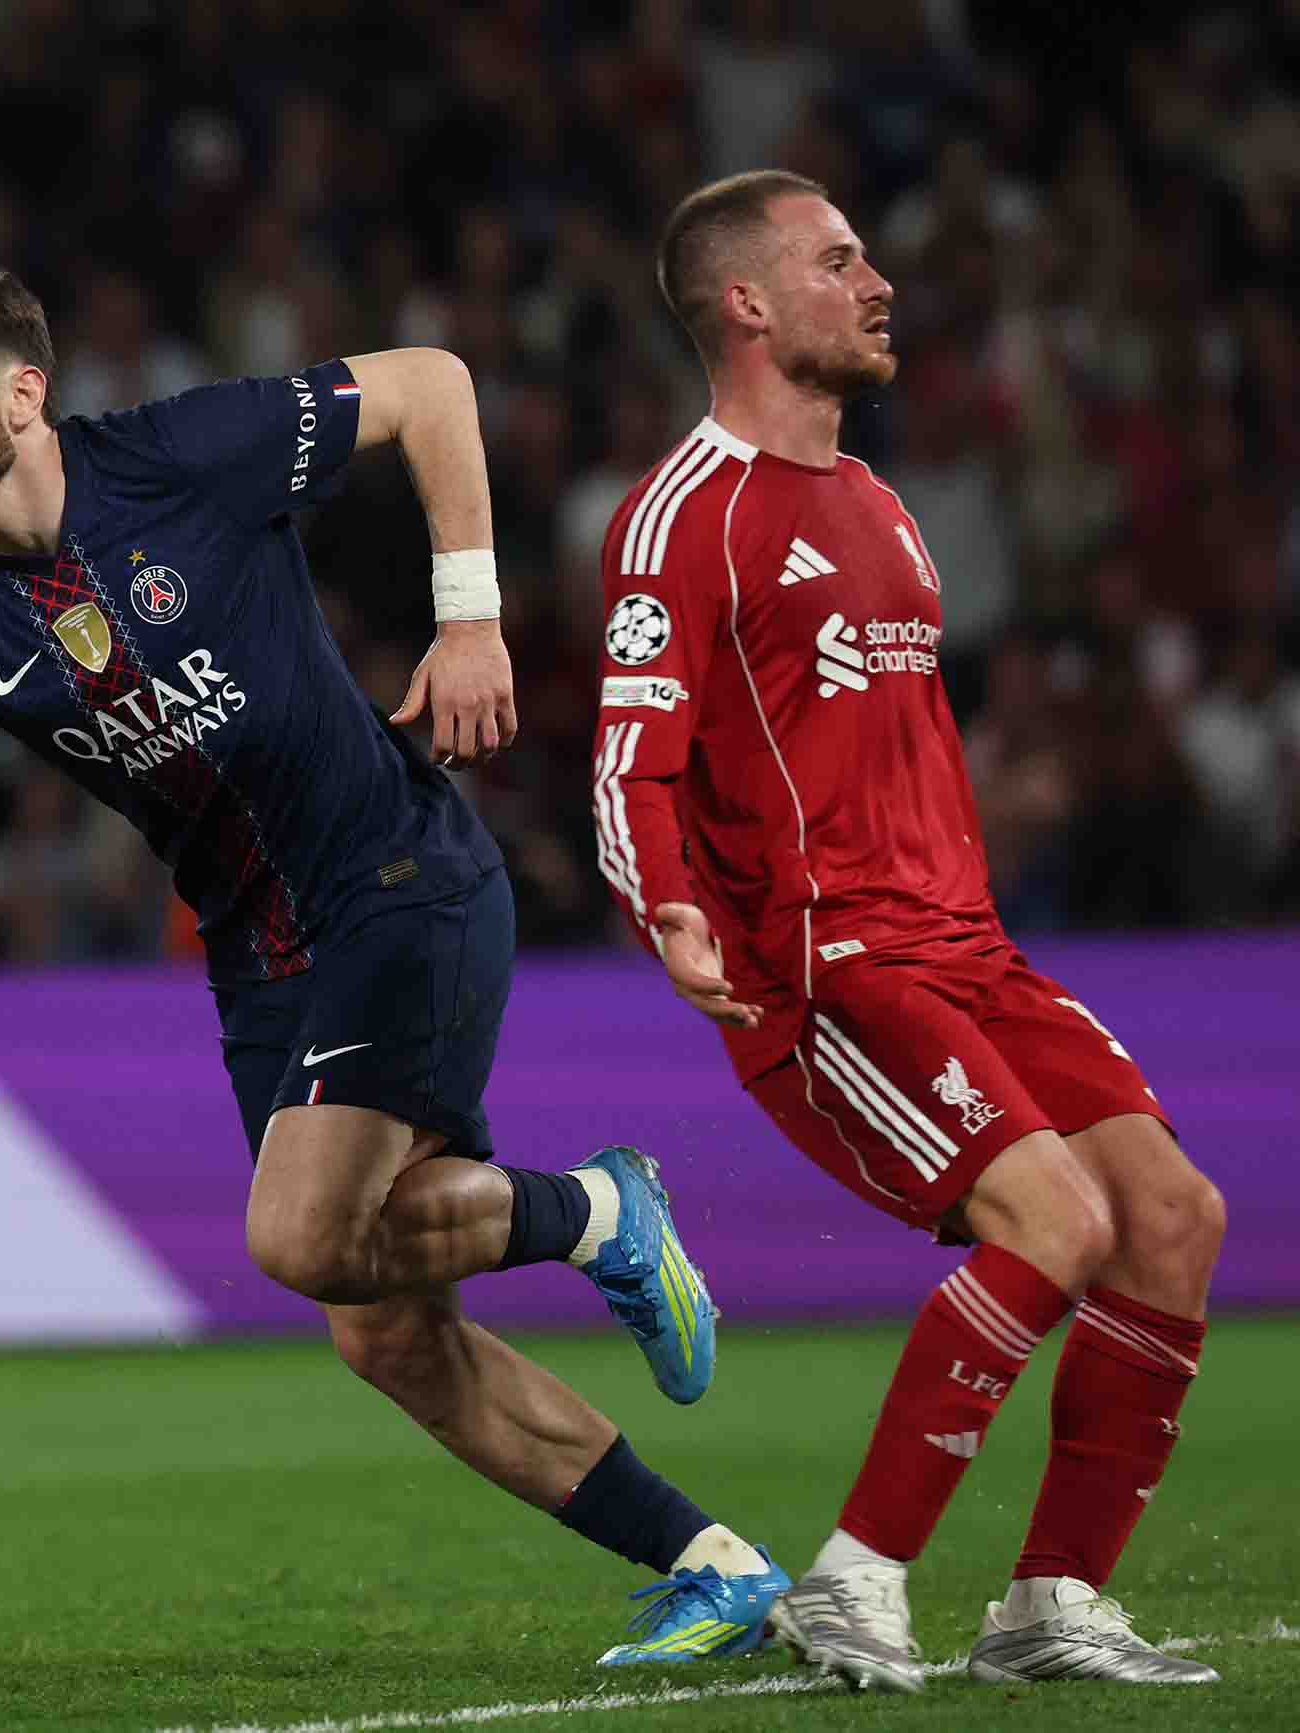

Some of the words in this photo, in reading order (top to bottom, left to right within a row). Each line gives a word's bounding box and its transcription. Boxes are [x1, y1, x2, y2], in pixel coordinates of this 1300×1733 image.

[290, 377, 317, 492] BEYOND
[133, 568, 166, 593] PARIS
[865, 616, 942, 647] standar
[52, 648, 229, 764] QATAR
[121, 681, 247, 778] AIRWAYS
